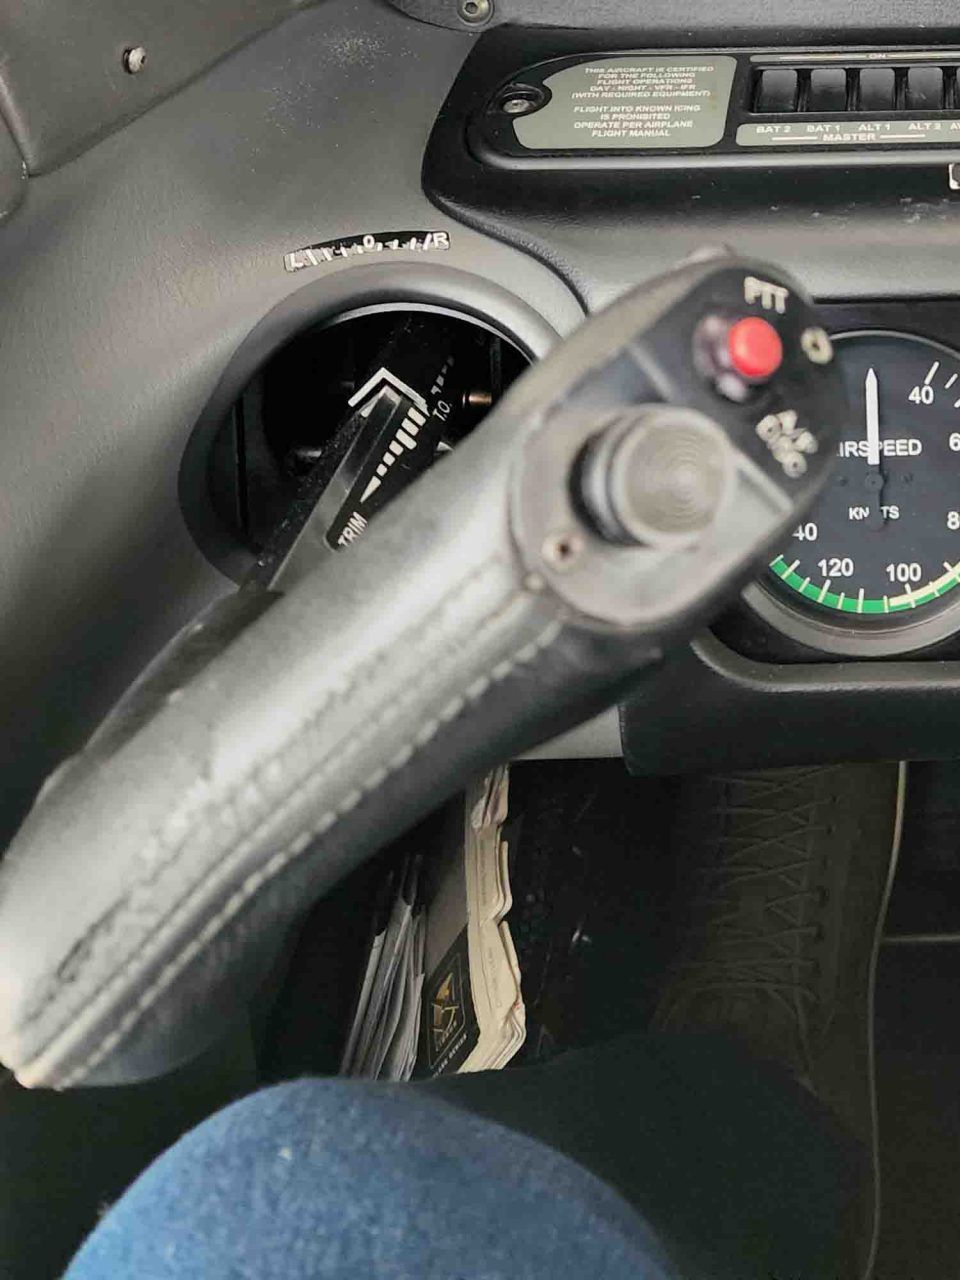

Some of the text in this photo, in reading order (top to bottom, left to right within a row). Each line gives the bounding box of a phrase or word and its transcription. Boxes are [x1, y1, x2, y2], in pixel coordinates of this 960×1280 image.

[574, 121, 620, 129] OPERATE
[644, 120, 693, 128] AIRPLANE
[756, 125, 781, 133] BAT
[806, 124, 832, 133] BAT
[858, 123, 882, 131] ALT
[908, 123, 932, 131] ALT
[629, 129, 670, 137] MANUAL
[823, 133, 876, 141] MASTER
[908, 386, 934, 405] 40
[849, 506, 899, 520] KNTS
[337, 511, 368, 548] TRIM
[792, 523, 818, 541] 40
[818, 558, 854, 577] 120
[886, 563, 922, 582] 100
